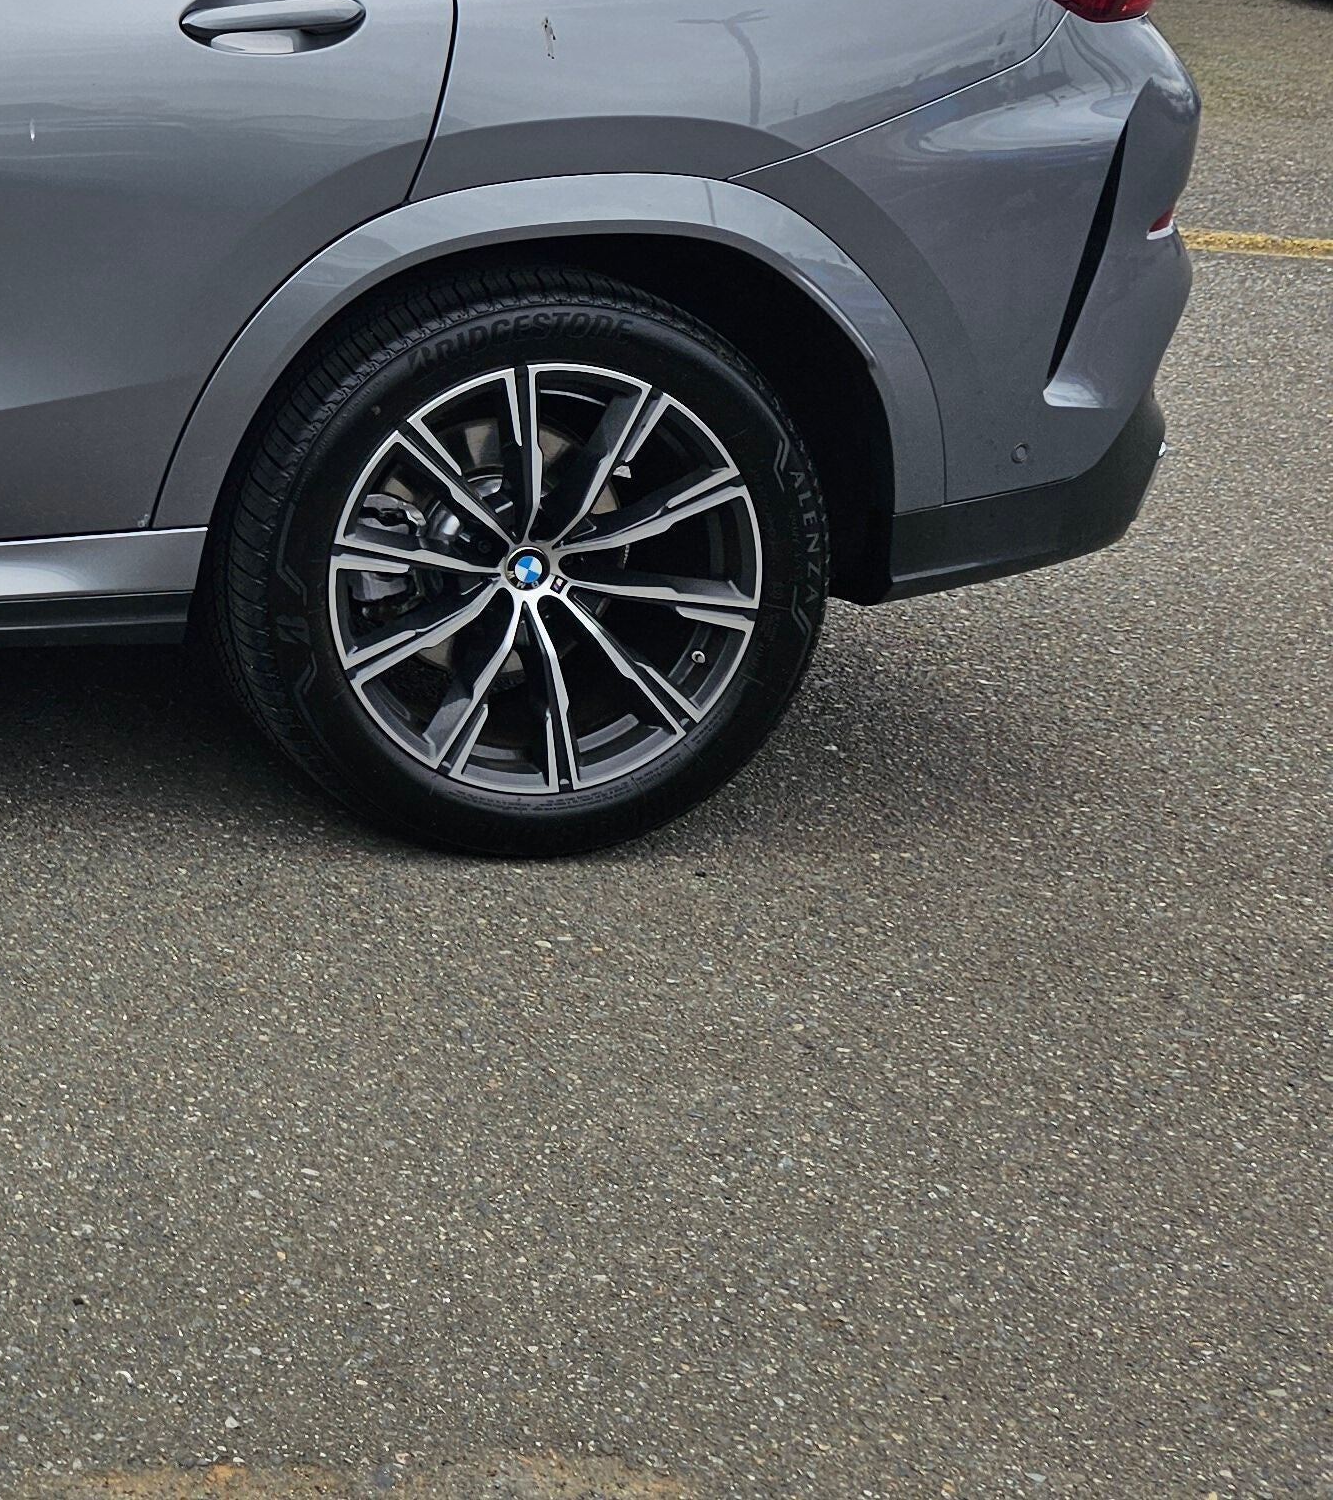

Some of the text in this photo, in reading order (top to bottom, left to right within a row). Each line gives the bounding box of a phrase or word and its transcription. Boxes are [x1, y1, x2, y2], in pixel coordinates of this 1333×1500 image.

[406, 311, 635, 371] BRIDGESTONE
[789, 471, 822, 604] ALENZA
[506, 570, 540, 590] BMW
